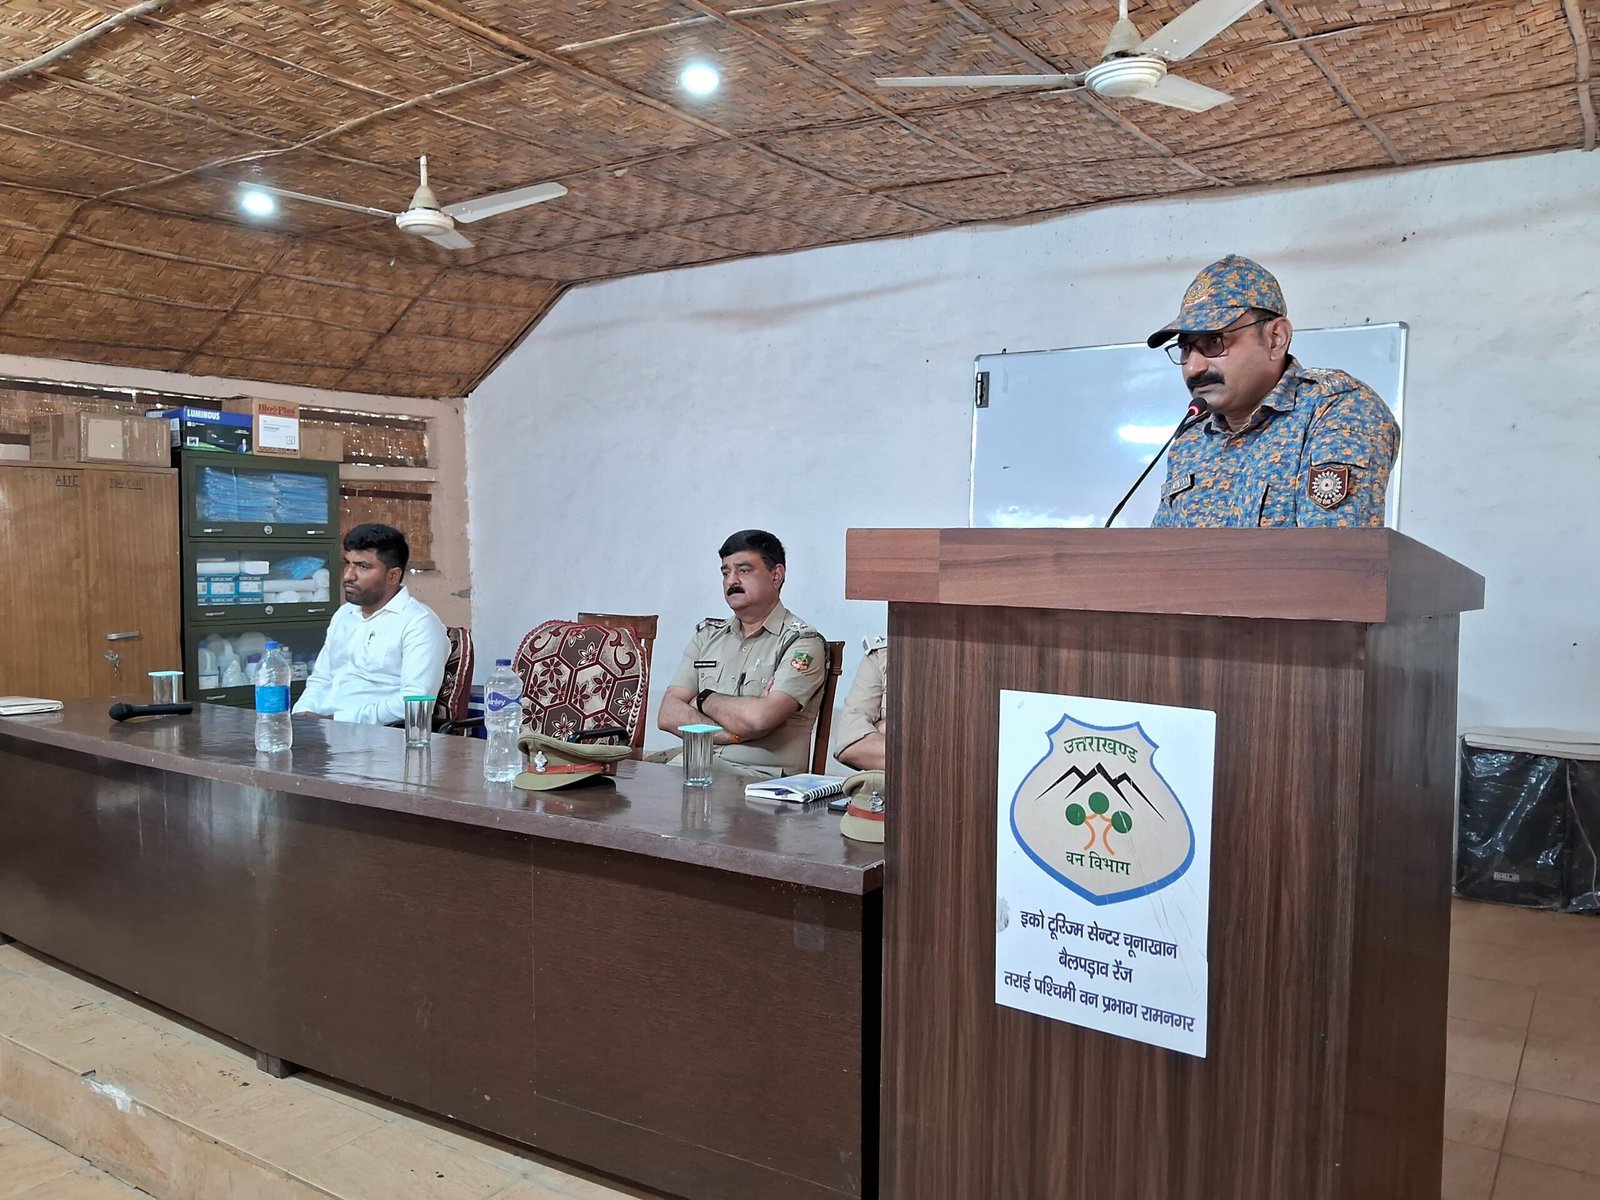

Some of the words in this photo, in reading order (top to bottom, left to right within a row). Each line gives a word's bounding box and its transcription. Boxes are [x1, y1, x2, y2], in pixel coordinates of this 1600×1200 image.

[187, 408, 220, 421] LUMINOUS
[1063, 736, 1138, 764] उत्तराखण्ड
[1066, 851, 1085, 867] वन
[1089, 850, 1131, 875] विभाग
[1020, 909, 1044, 929] इको
[1048, 912, 1084, 940] टूरिज्म
[1088, 920, 1121, 946] सेन्टर
[1123, 933, 1177, 959] चूनाखान
[1058, 946, 1109, 979] बैलपड़ाव
[1112, 959, 1133, 983] रेंज
[1004, 970, 1031, 993] तराई
[1034, 976, 1076, 1003] पश्चिमी
[1079, 989, 1098, 1008] वन
[1102, 995, 1138, 1019] प्रभाग
[1141, 1005, 1195, 1033] रामनगर
